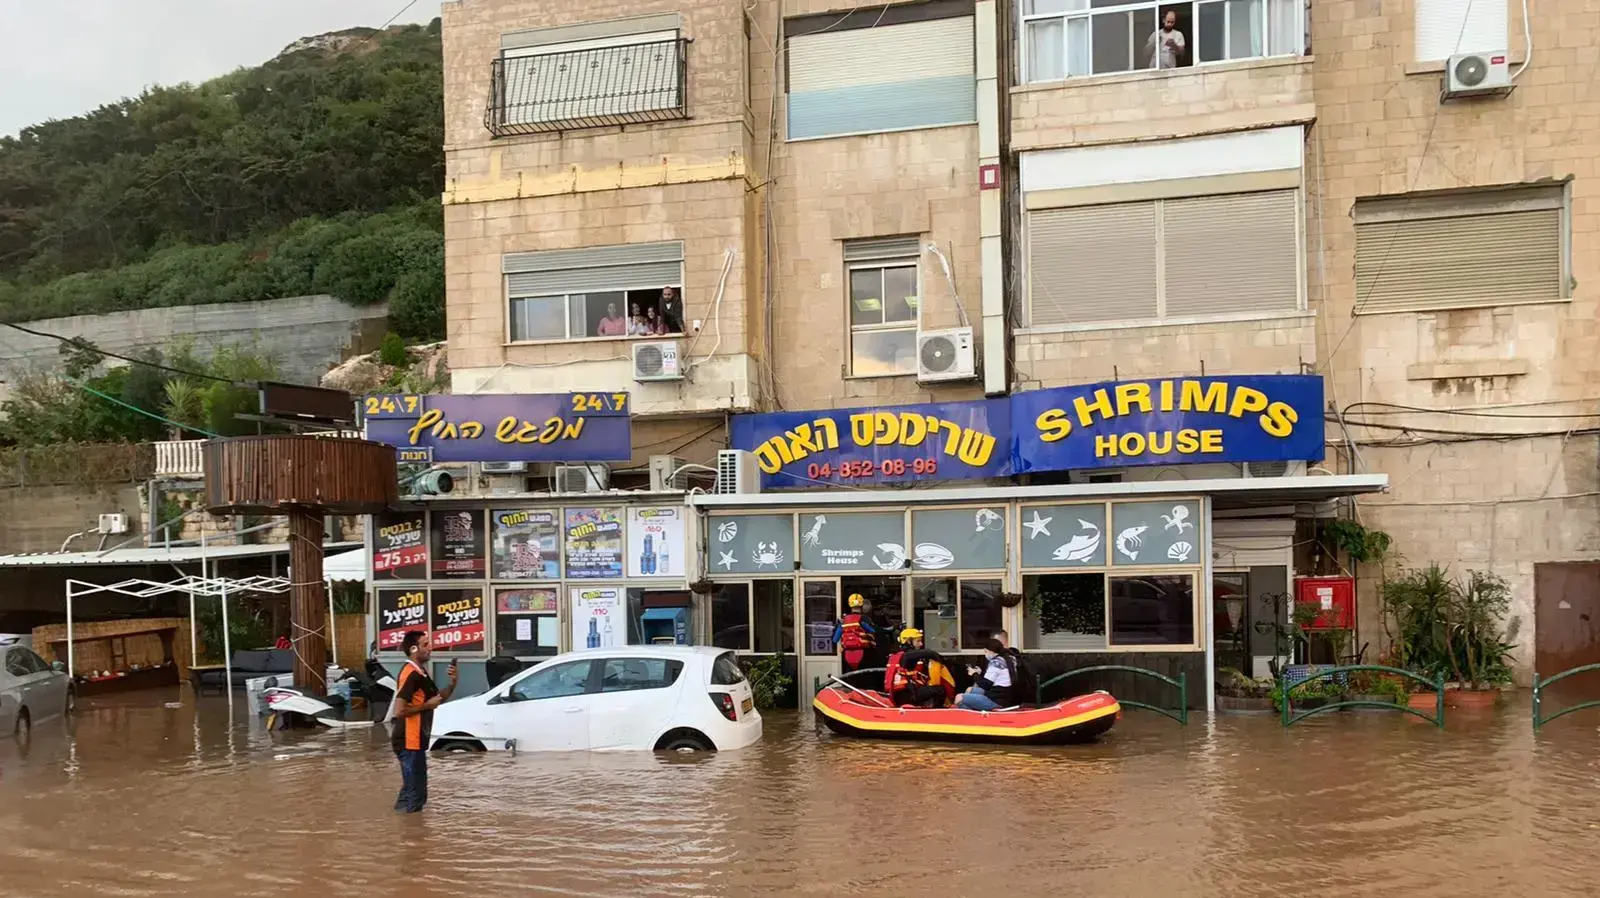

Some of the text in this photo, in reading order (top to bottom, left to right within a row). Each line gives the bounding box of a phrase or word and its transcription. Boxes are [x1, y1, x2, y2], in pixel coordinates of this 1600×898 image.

[1035, 380, 1299, 442] SHRIMPS
[408, 408, 585, 445] מפגש החוף
[752, 411, 996, 474] שרימפס האוס
[1095, 429, 1223, 457] HOUSE
[400, 451, 427, 460] חנות
[808, 458, 936, 479] 04-852-08-96
[416, 519, 422, 529] 2
[388, 530, 421, 546] שניצל
[821, 549, 864, 558] Shrimps
[398, 592, 424, 608] חלה
[474, 597, 481, 607] 3
[384, 605, 424, 624] שניצל
[445, 608, 479, 623] שניצל
